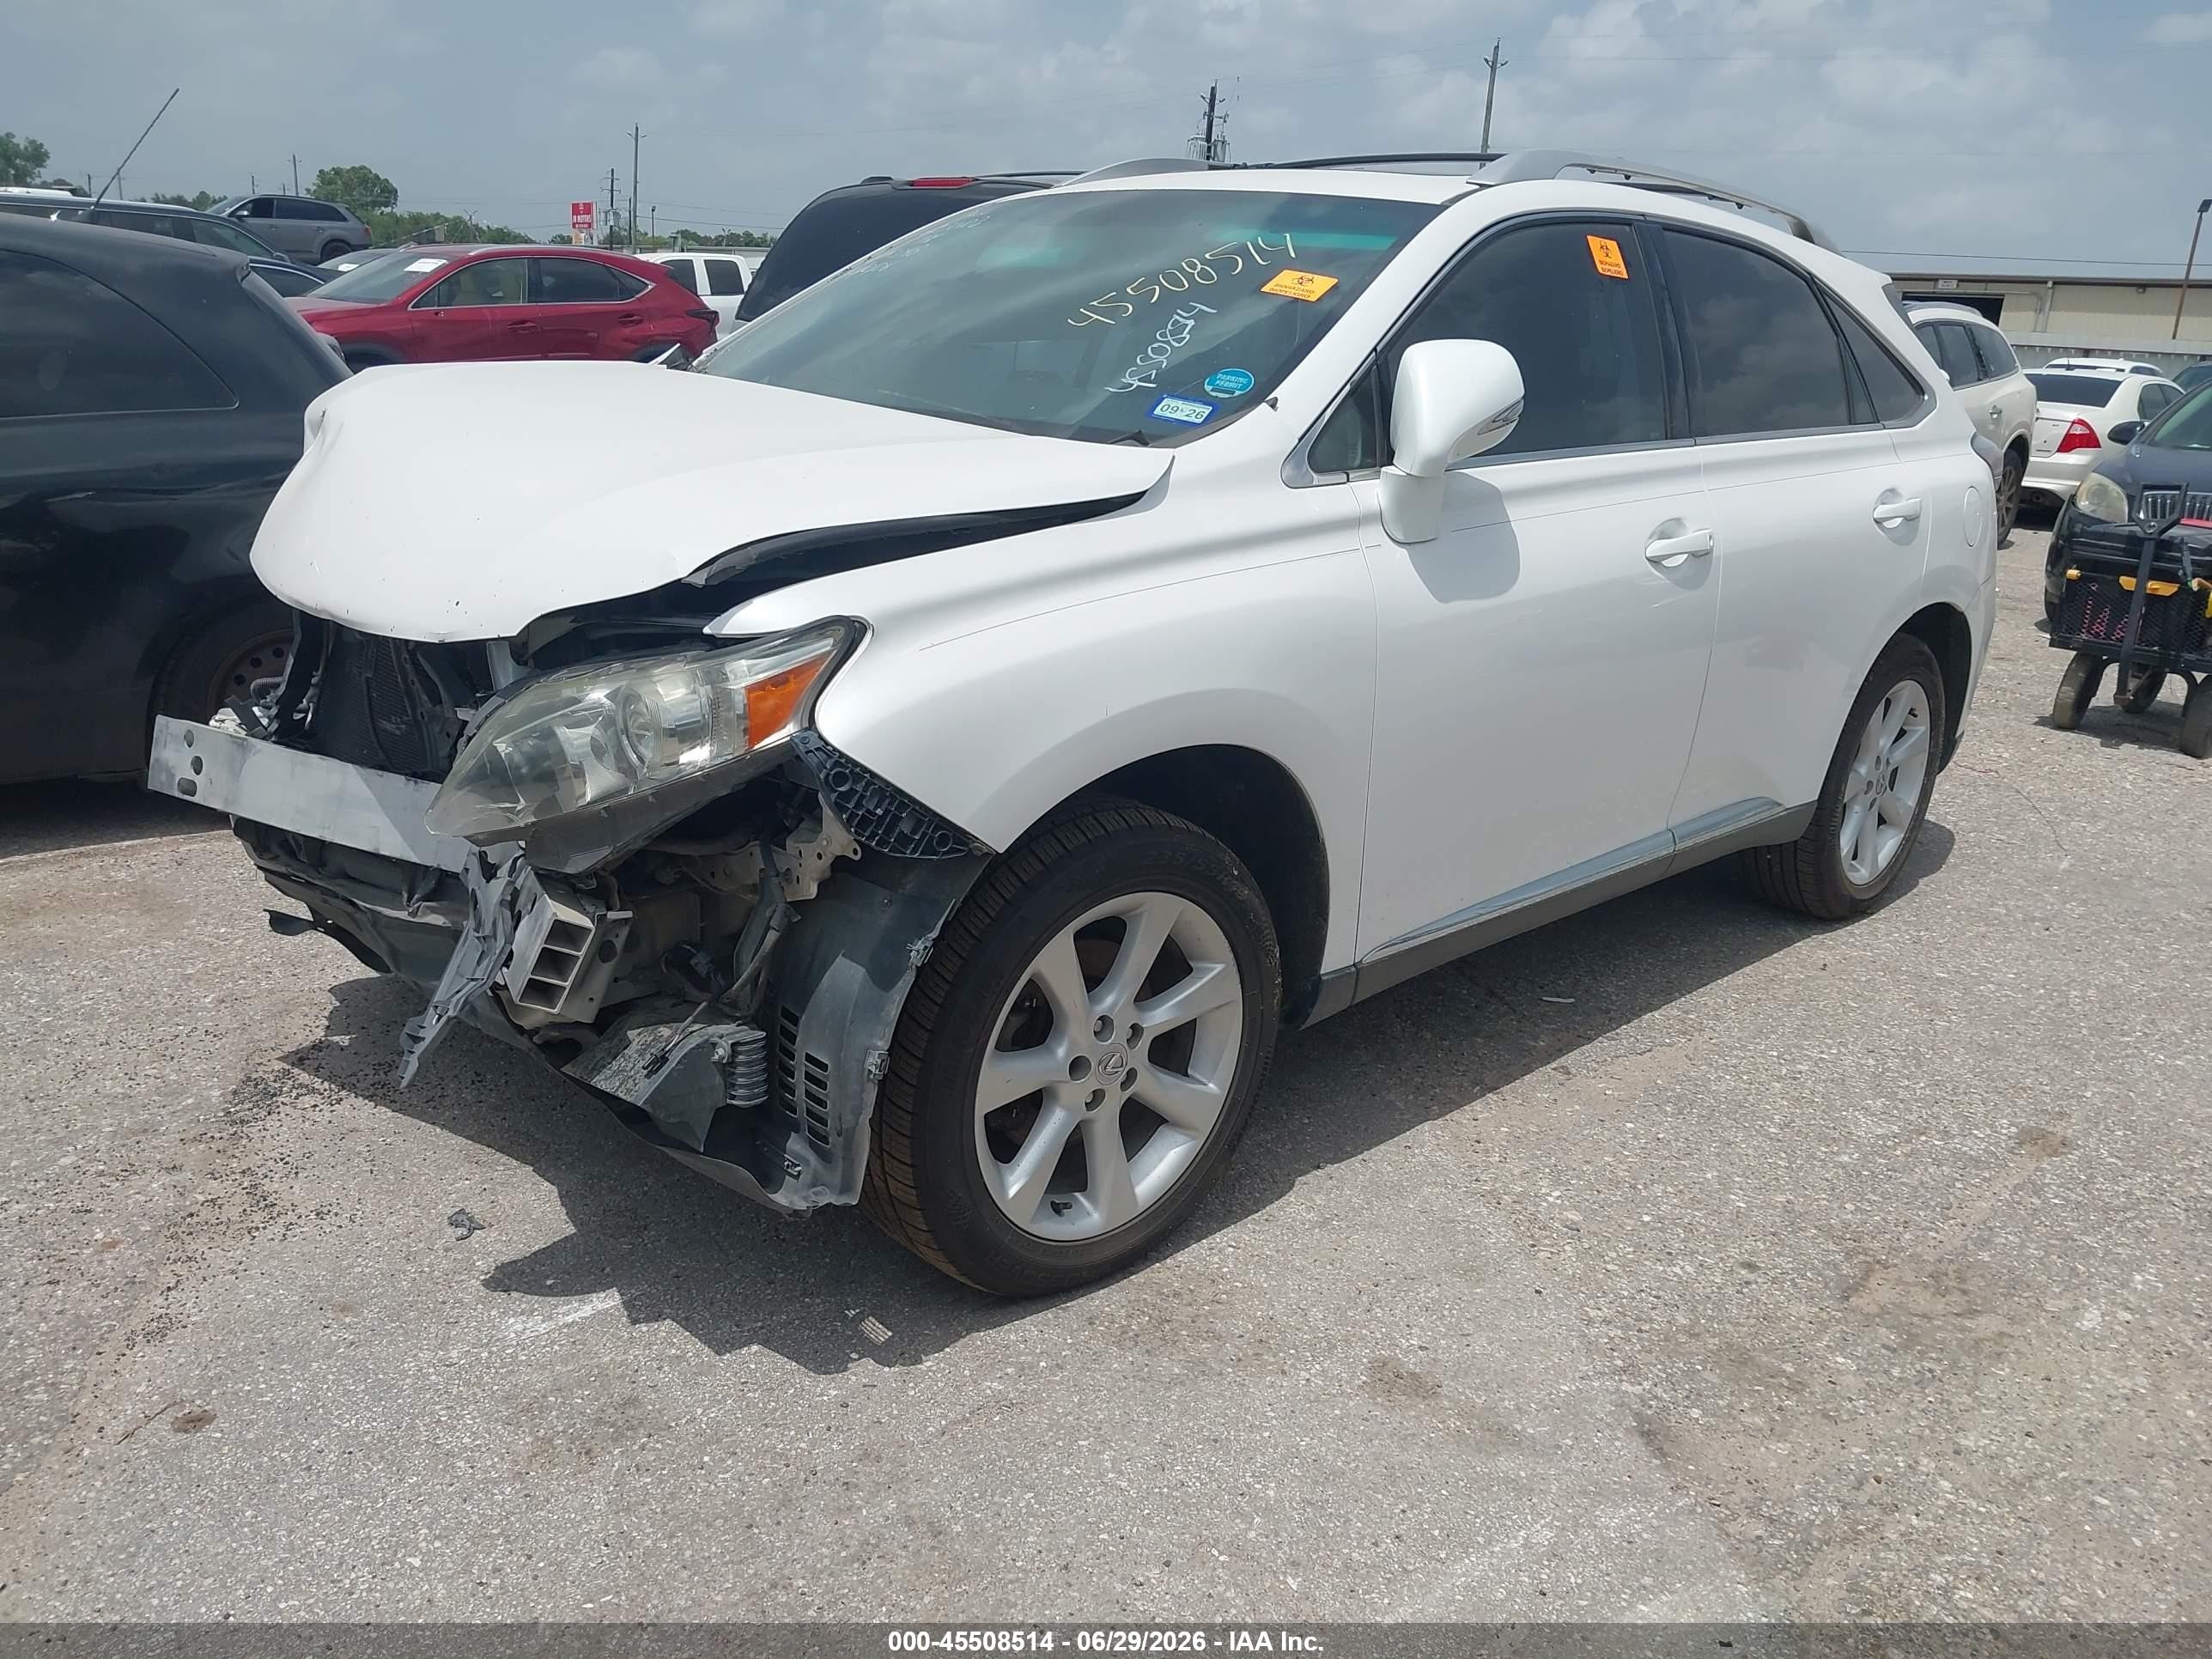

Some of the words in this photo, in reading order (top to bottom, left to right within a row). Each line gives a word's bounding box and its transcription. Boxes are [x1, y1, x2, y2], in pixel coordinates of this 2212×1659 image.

[1067, 233, 1296, 326] 45508514
[1214, 380, 1243, 389] PERMIT
[1216, 374, 1249, 384] PARKING
[1160, 404, 1180, 415] 09
[1185, 409, 1206, 420] 26
